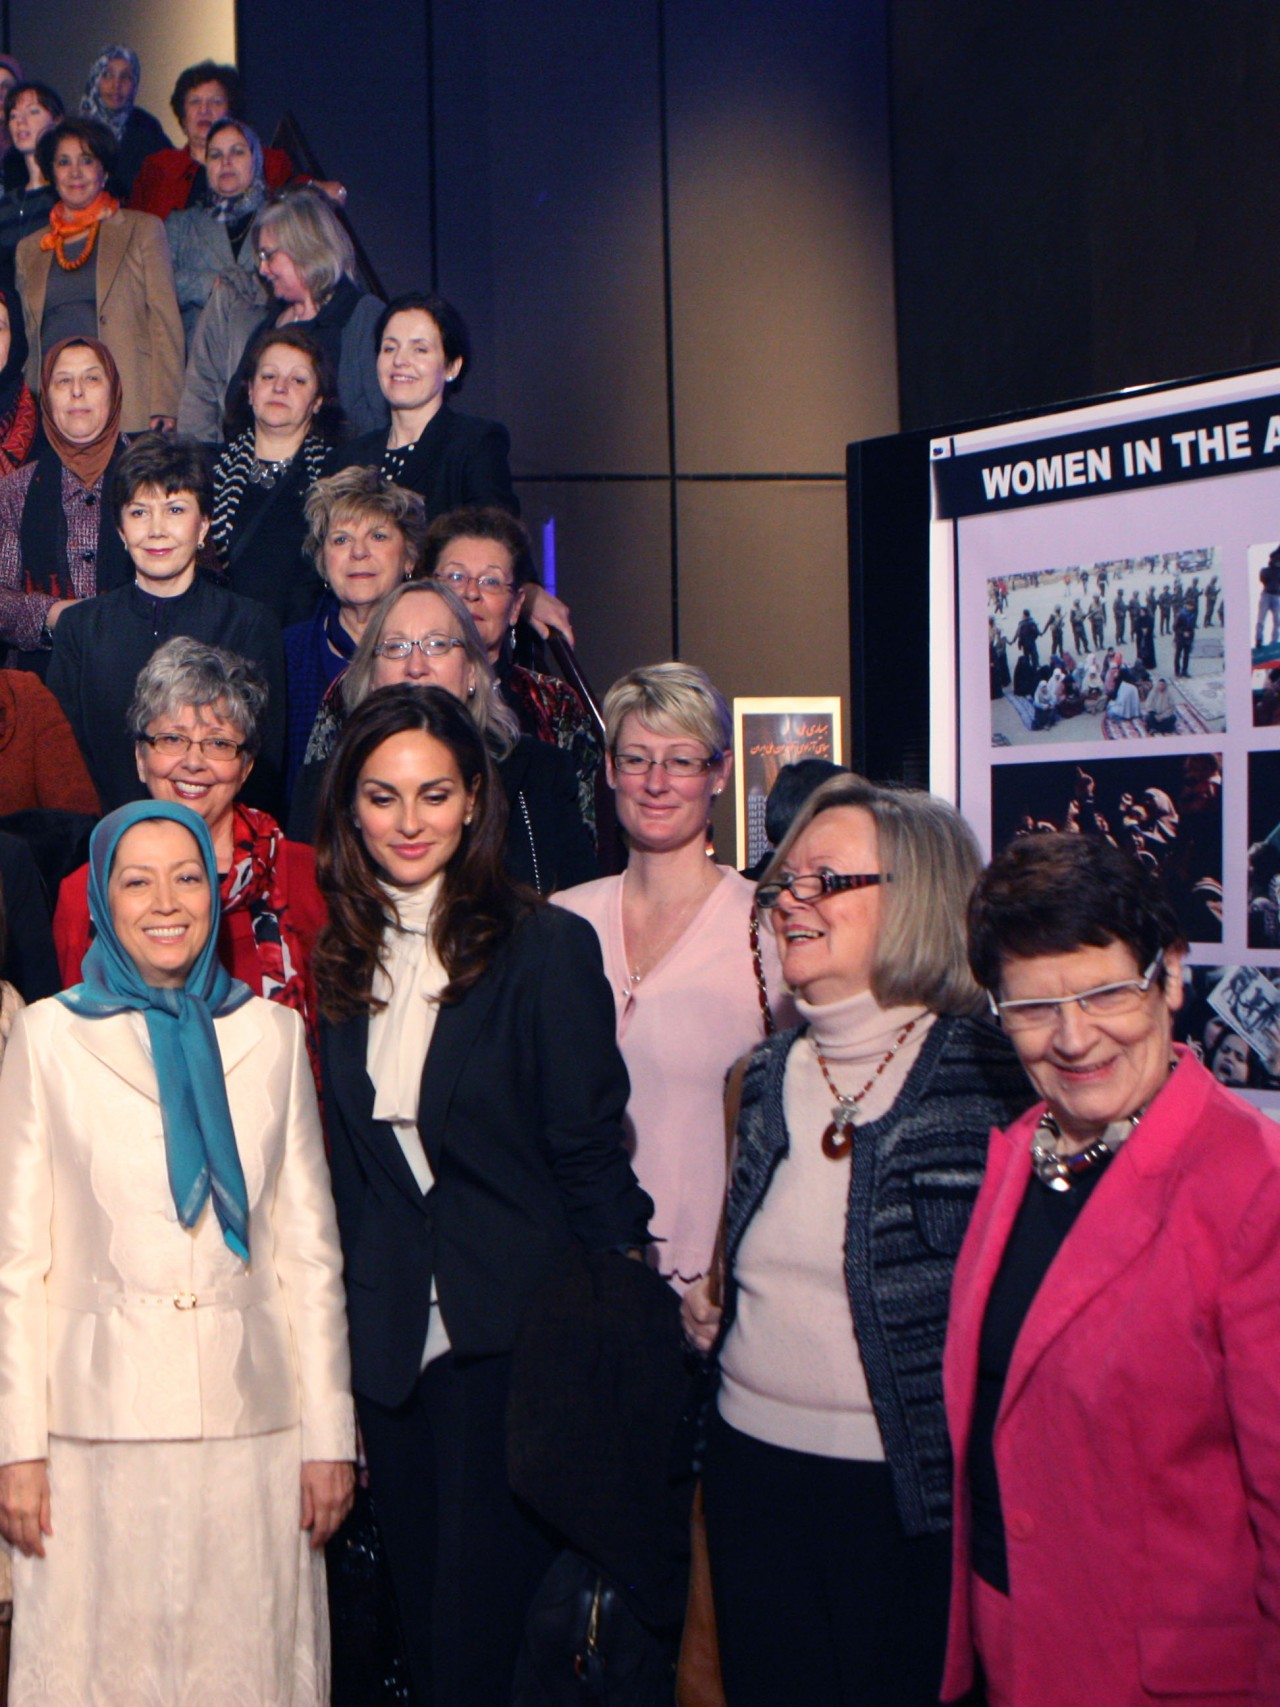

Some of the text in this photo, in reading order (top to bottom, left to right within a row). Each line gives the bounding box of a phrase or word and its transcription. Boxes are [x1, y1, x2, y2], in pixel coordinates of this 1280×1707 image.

[982, 446, 1112, 500] WOMEN
[1123, 437, 1162, 477] IN
[1171, 421, 1252, 468] THE
